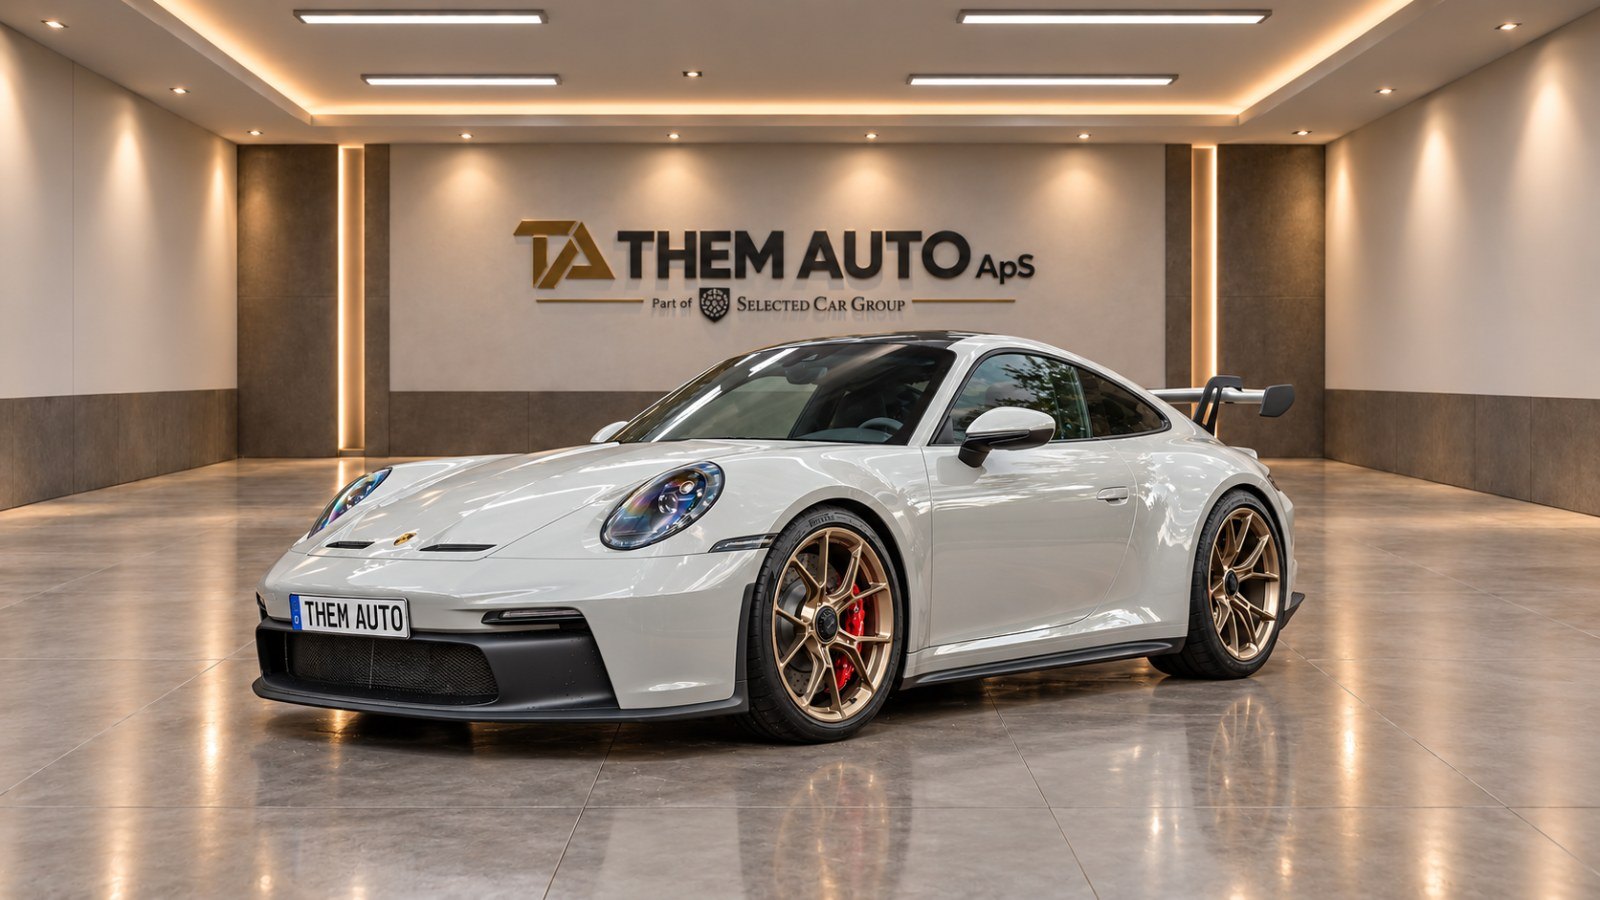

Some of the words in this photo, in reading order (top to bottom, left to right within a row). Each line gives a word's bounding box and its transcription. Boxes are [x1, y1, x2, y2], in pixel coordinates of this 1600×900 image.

[617, 230, 784, 279] THEM
[796, 230, 971, 280] AUTO
[975, 253, 1036, 285] ApS
[652, 297, 677, 309] Part
[679, 297, 693, 309] of
[737, 296, 810, 312] SELECTED
[851, 296, 906, 312] GROUP
[304, 601, 349, 628] THEM
[356, 603, 403, 631] AUTO
